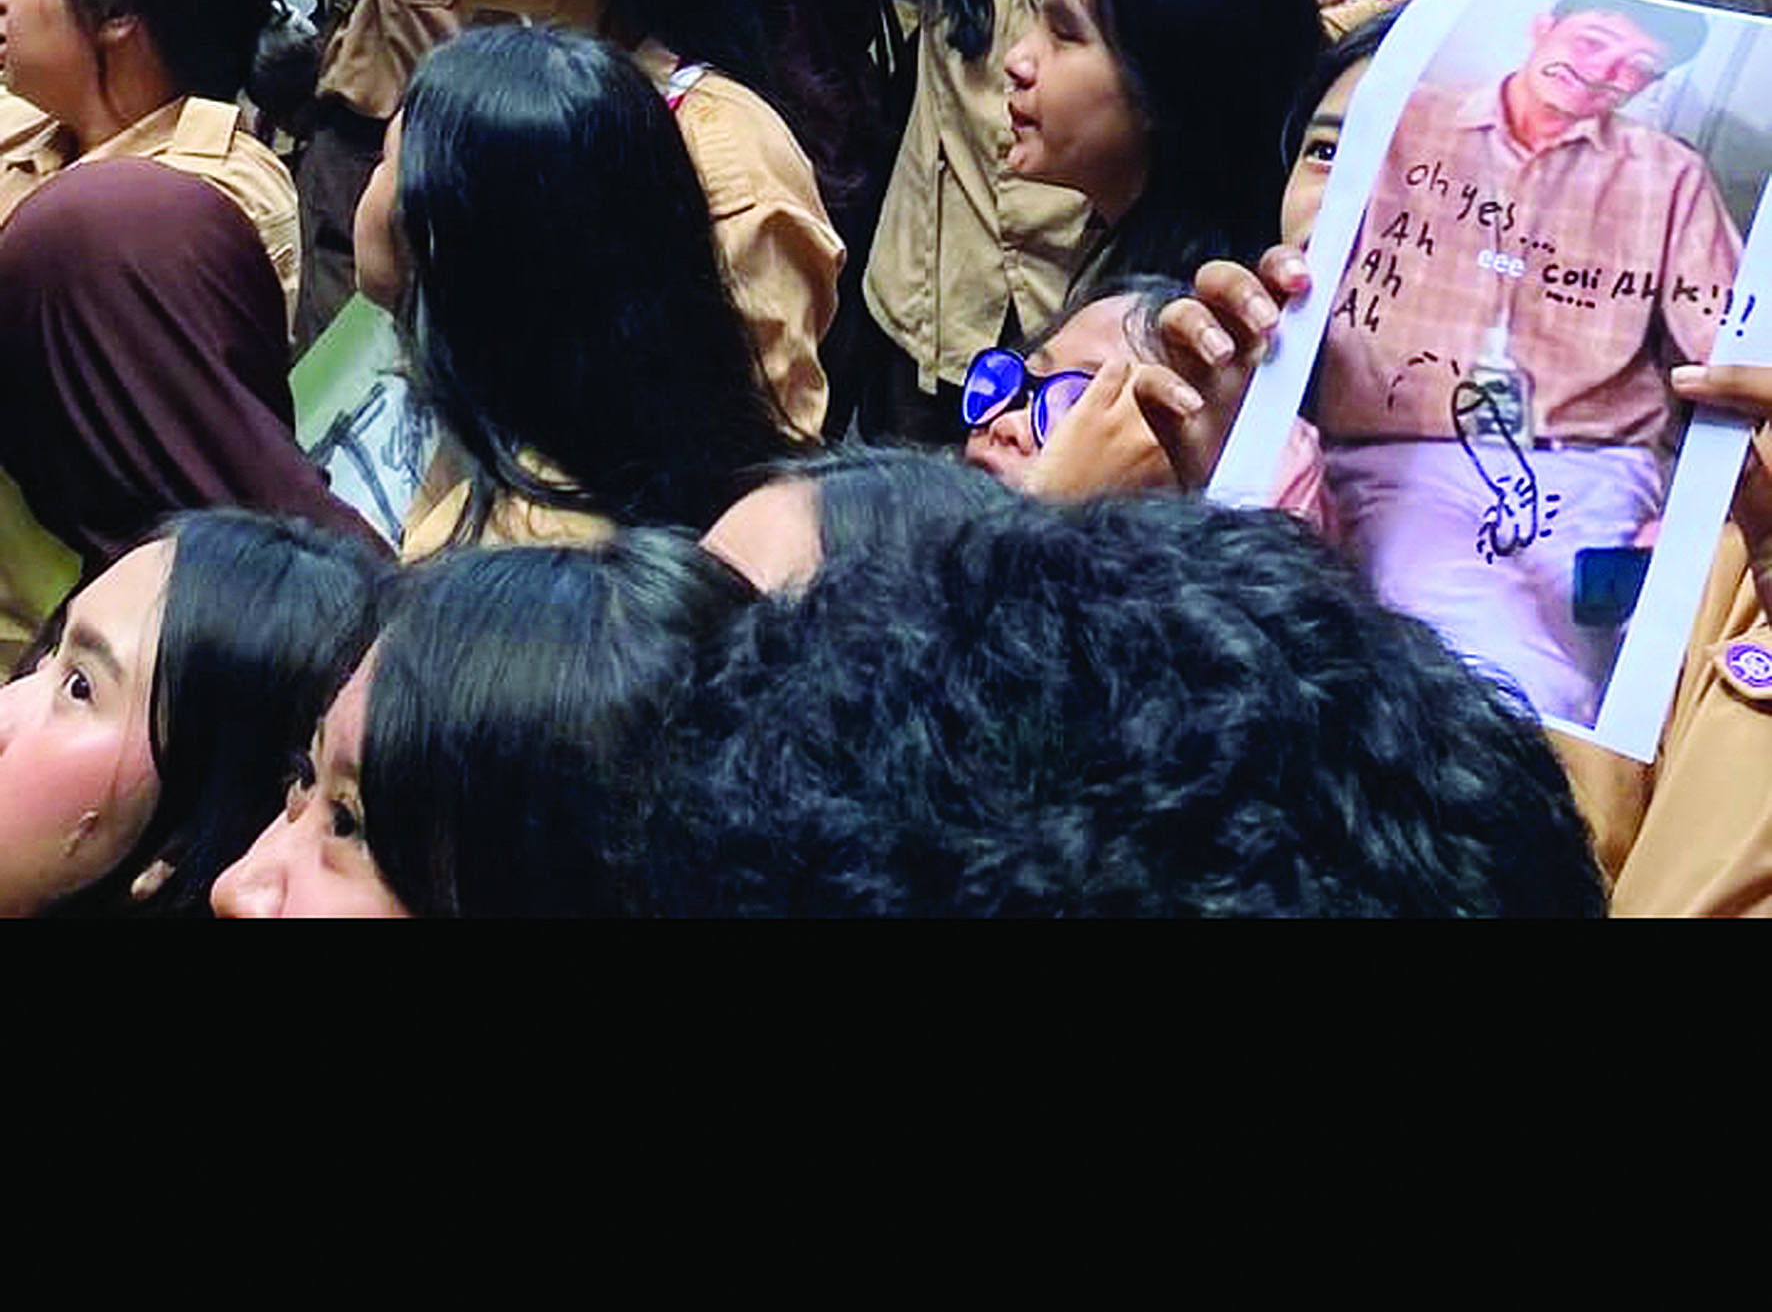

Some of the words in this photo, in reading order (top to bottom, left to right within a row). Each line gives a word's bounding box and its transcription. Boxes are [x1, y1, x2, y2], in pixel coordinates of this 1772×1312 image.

[1380, 212, 1434, 255] Ah
[1361, 249, 1401, 297] Ah
[1334, 287, 1380, 332] Ah
